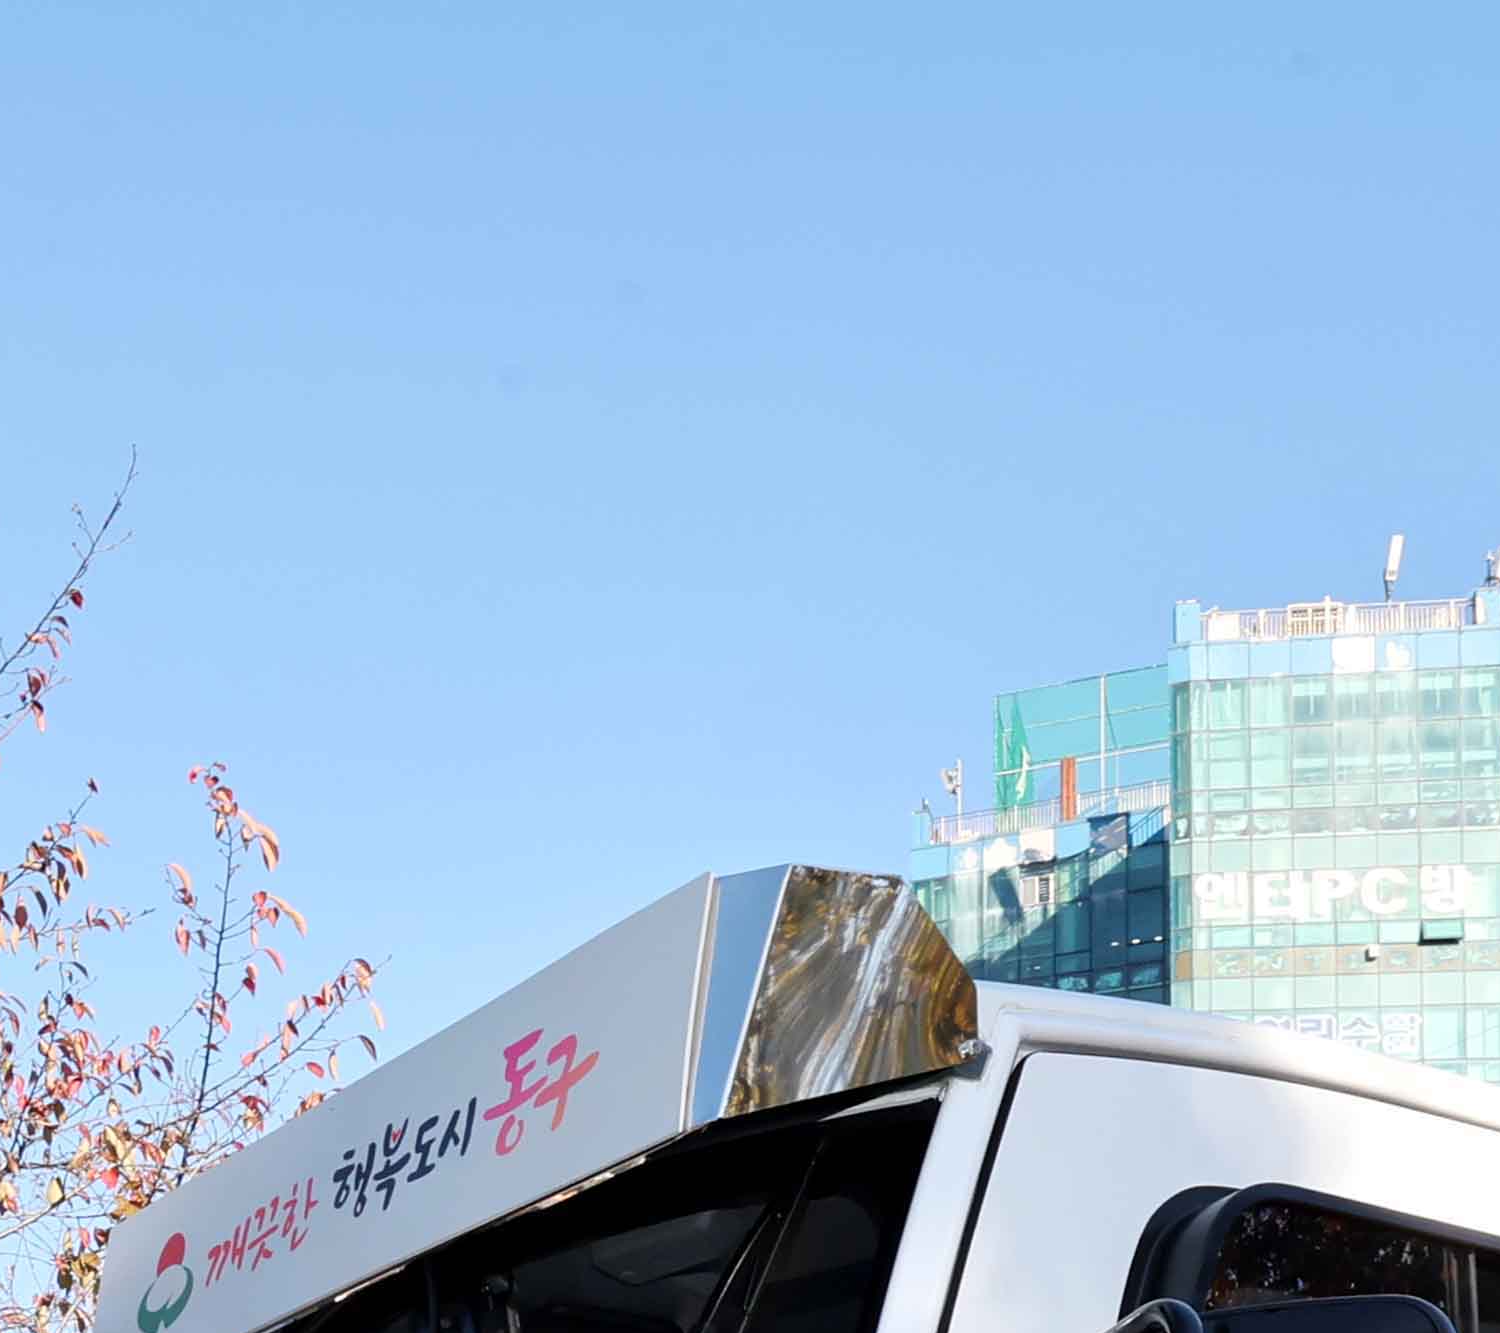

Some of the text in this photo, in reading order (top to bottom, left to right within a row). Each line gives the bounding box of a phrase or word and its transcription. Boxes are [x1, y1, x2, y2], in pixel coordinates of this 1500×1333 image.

[1194, 865, 1472, 921] 엔터PC방
[205, 1028, 600, 1288] 깨끗한 행복도시 동구
